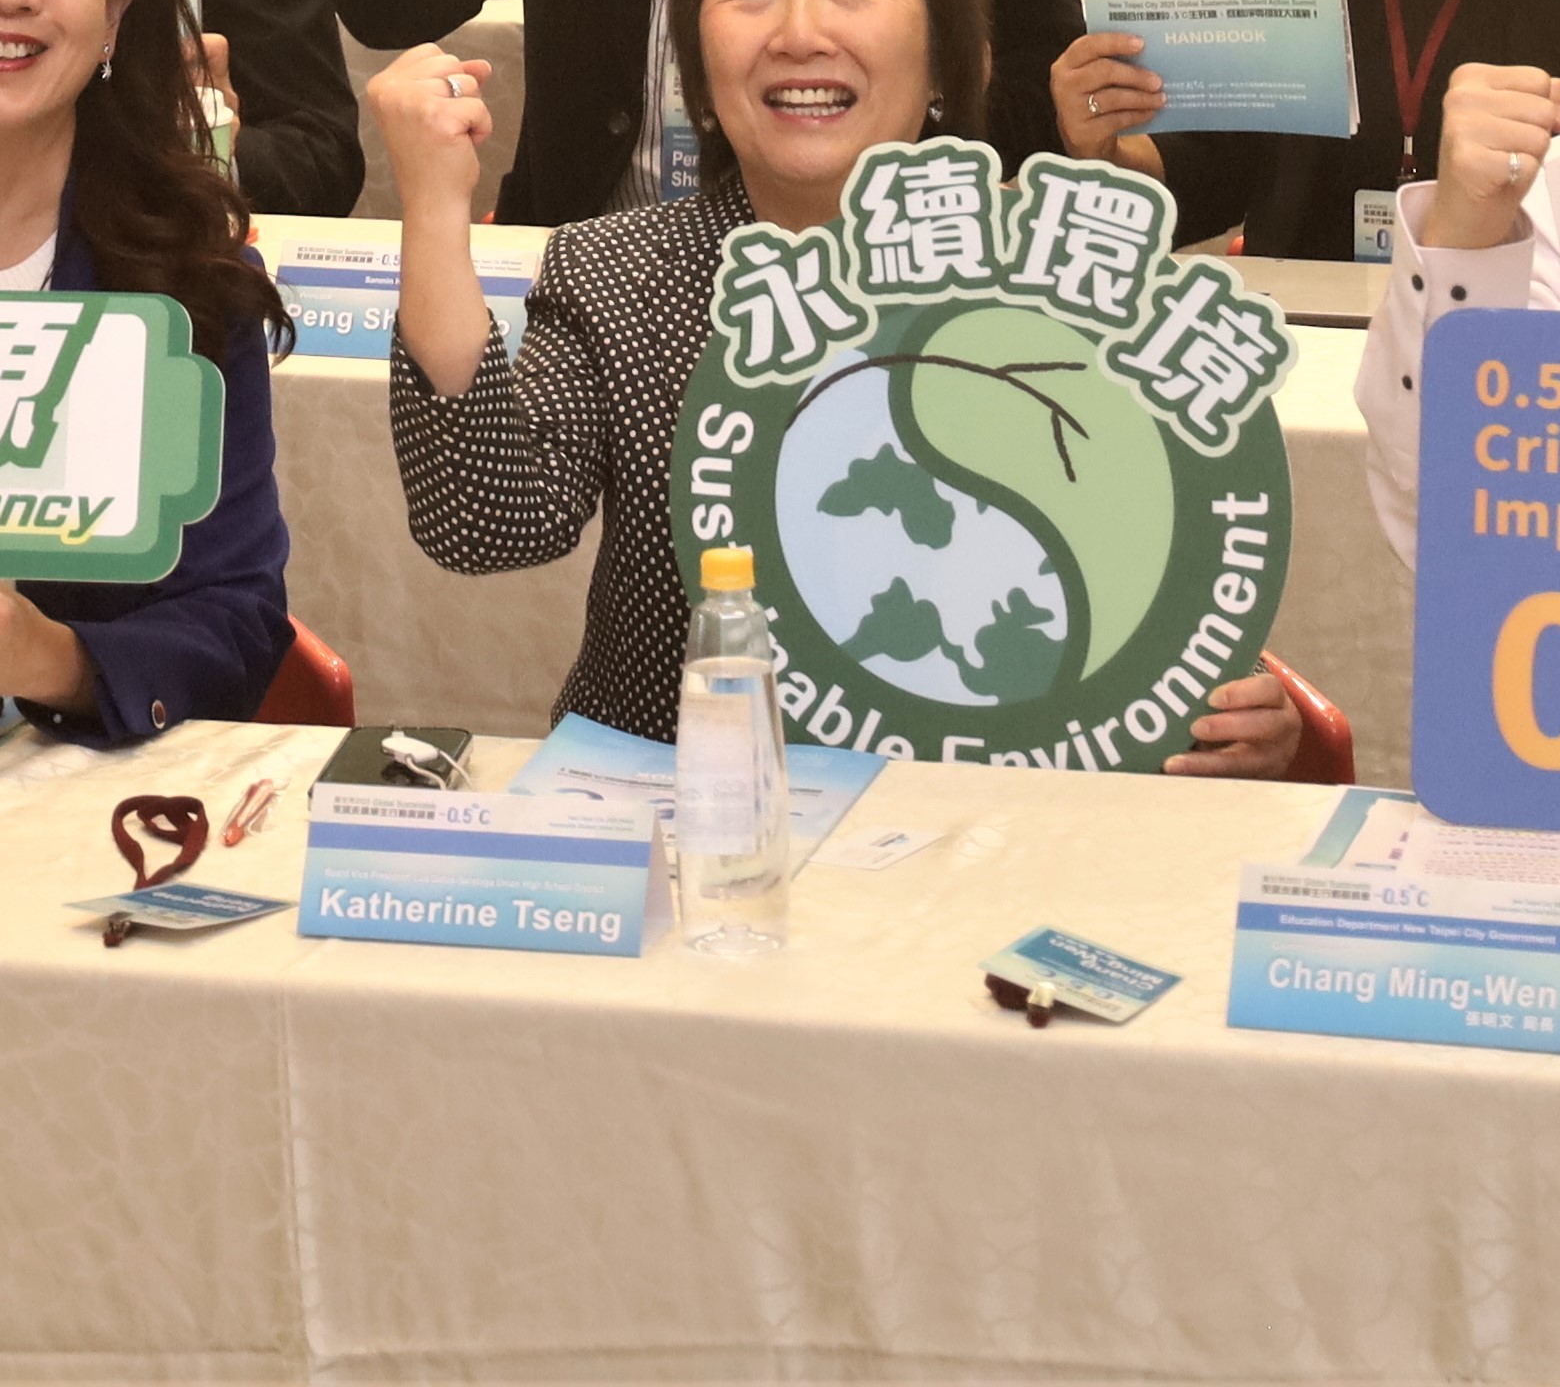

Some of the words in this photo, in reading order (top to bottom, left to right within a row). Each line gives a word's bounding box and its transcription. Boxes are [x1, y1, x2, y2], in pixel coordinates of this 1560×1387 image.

[1164, 30, 1266, 44] HANDBOOK
[730, 156, 1279, 436] 永續環境
[439, 803, 491, 825] -0.5°C
[320, 887, 498, 928] Katherine
[512, 899, 622, 944] Tseng
[1280, 914, 1334, 928] Education
[1337, 918, 1400, 933] Department
[1403, 924, 1426, 934] New
[1429, 925, 1461, 939] Taipei
[1464, 927, 1485, 942] City
[1489, 930, 1557, 946] Government
[1268, 957, 1377, 1004] Chang
[1388, 967, 1558, 1011] Ming-Wen
[1466, 1011, 1514, 1029] 張明文
